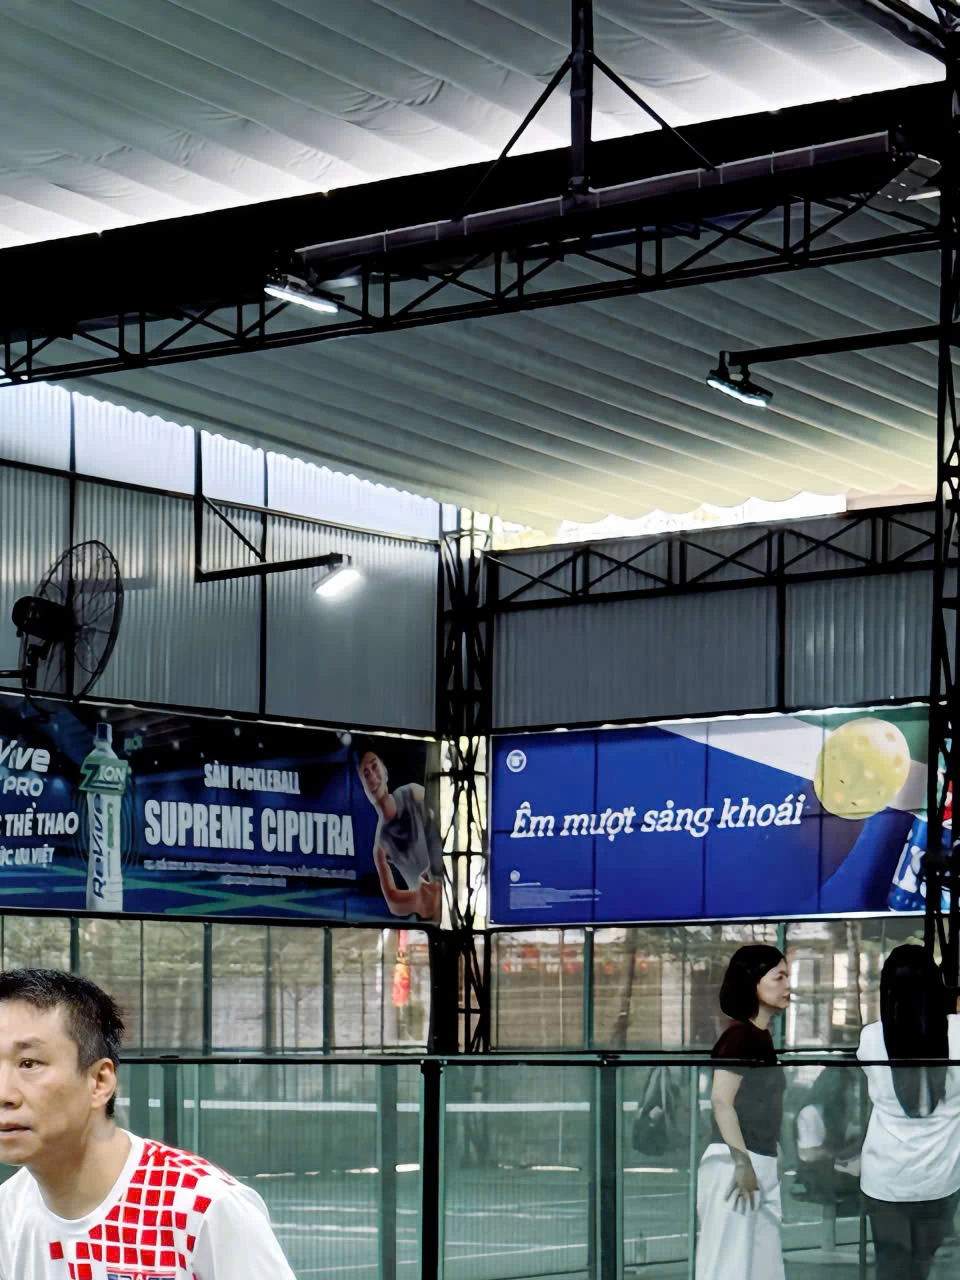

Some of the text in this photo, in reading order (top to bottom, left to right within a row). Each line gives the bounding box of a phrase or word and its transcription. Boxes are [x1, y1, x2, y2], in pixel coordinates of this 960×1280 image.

[2, 775, 44, 797] PRO
[232, 766, 301, 795] PICKLEBALL
[35, 811, 80, 836] THAO
[144, 799, 255, 850] SUPREME
[260, 807, 355, 857] CIPUTRA
[510, 800, 555, 839] Êm
[560, 806, 637, 842] mượt
[717, 793, 807, 829] khoái
